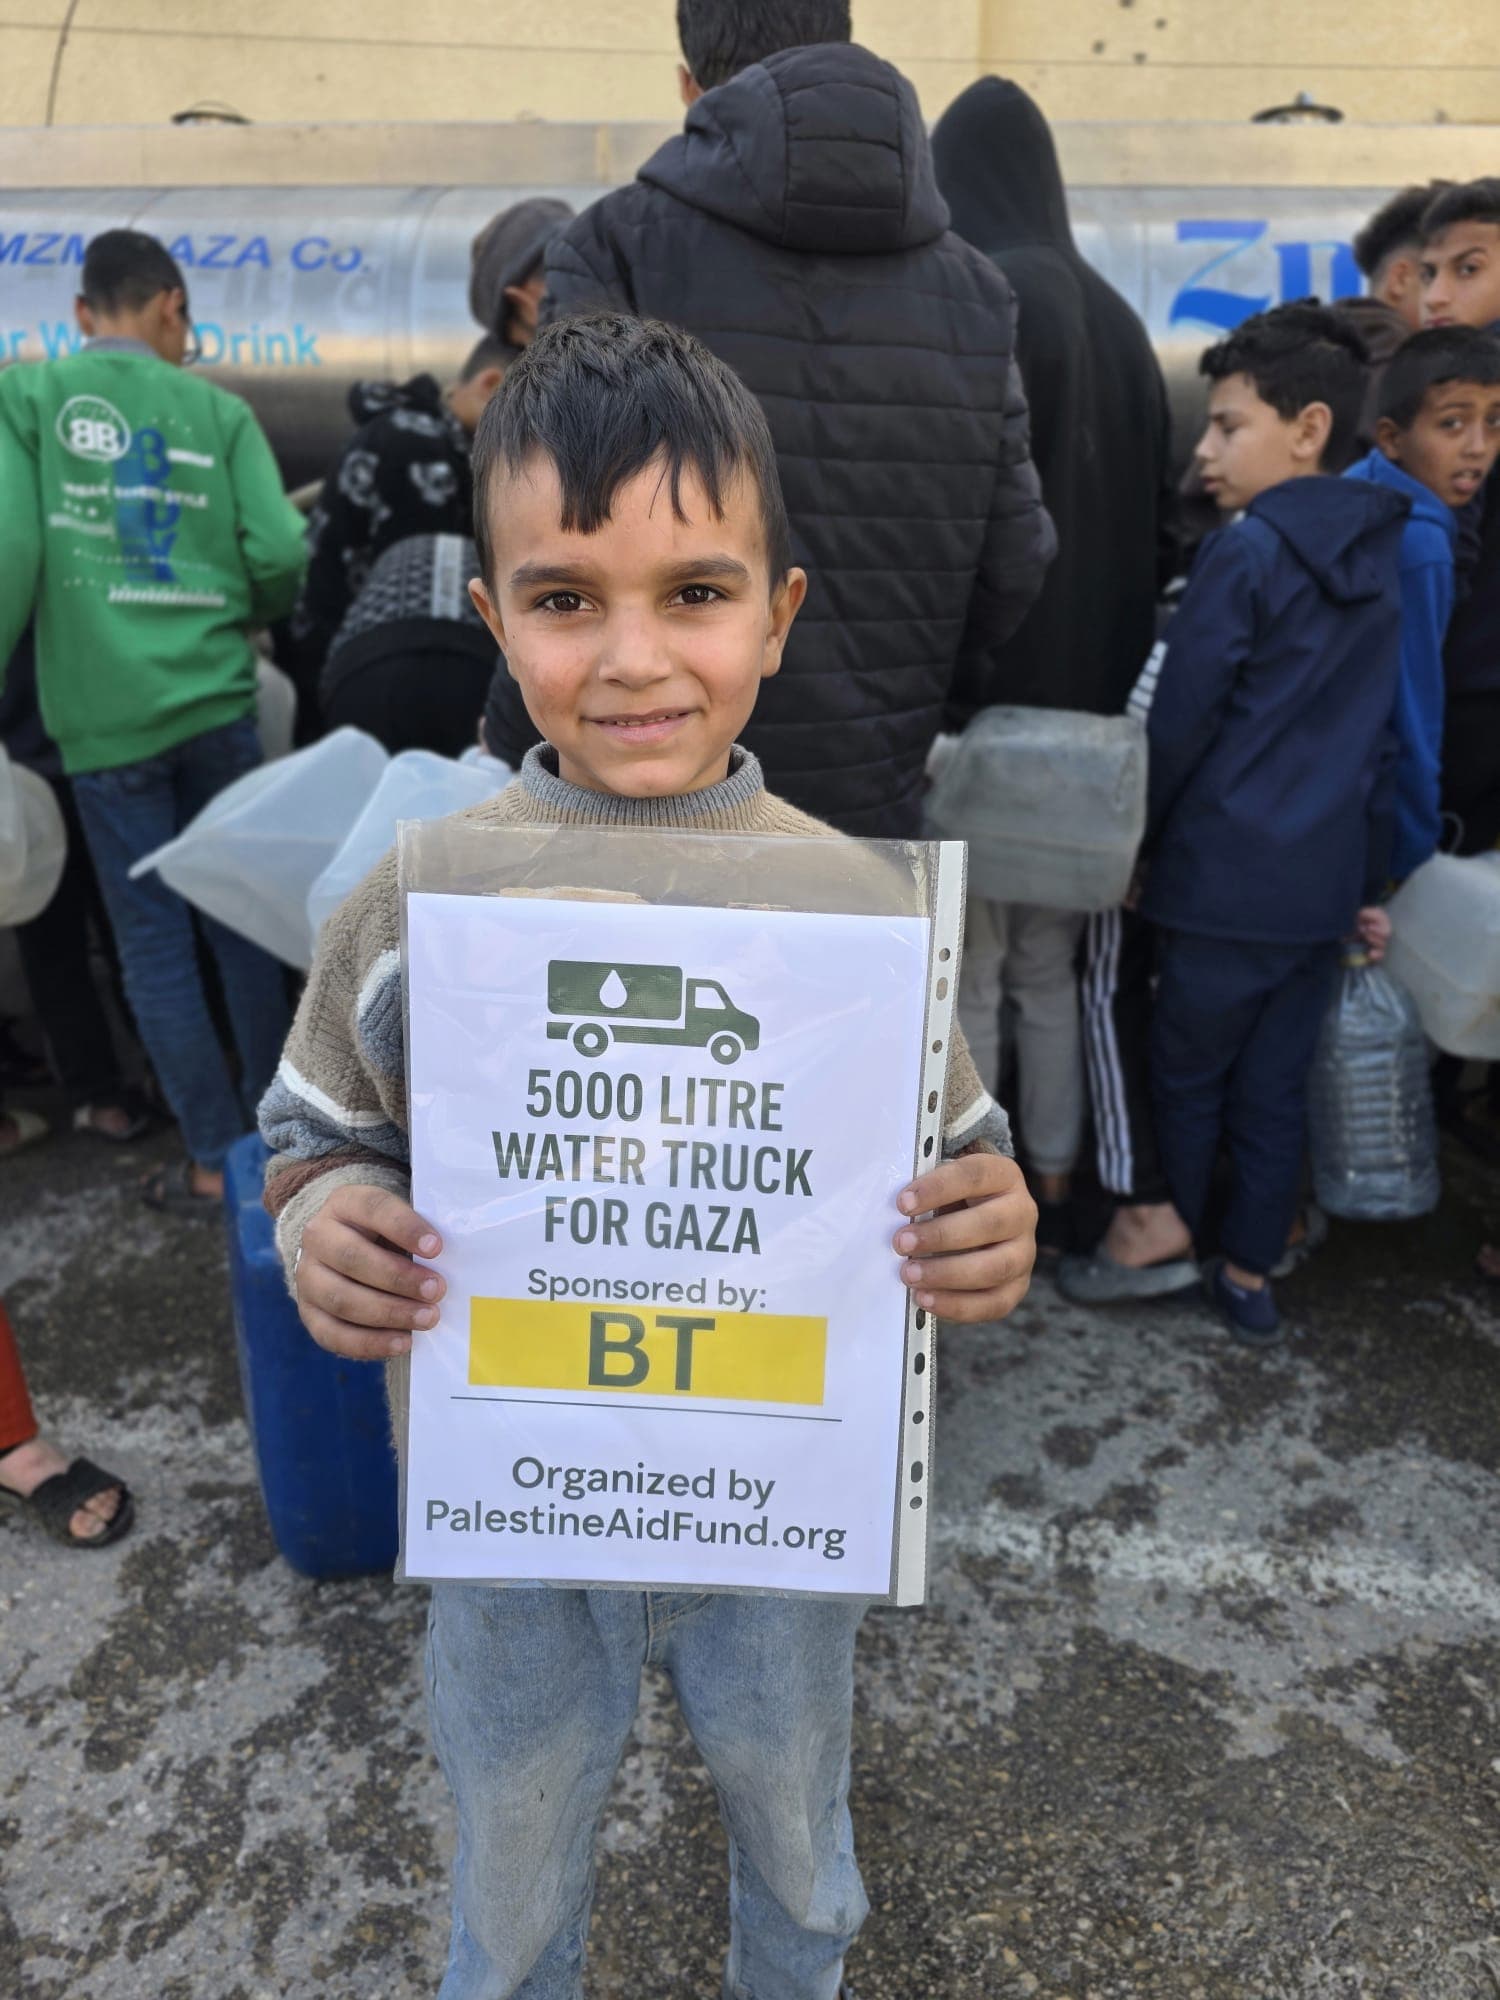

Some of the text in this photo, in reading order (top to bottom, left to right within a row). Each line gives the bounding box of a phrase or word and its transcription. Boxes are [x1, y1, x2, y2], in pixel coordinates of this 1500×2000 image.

[168, 234, 271, 269] AZA
[194, 322, 322, 366] Drink
[526, 1069, 784, 1132] 5000 LITRE
[492, 1131, 813, 1197] WATER TRUCK
[545, 1196, 761, 1255] FOR GAZA
[527, 1269, 766, 1312] Sponsored by:
[588, 1311, 715, 1391] BT
[512, 1457, 776, 1510] Organized by
[426, 1500, 847, 1560] PalestineAidFund.org
